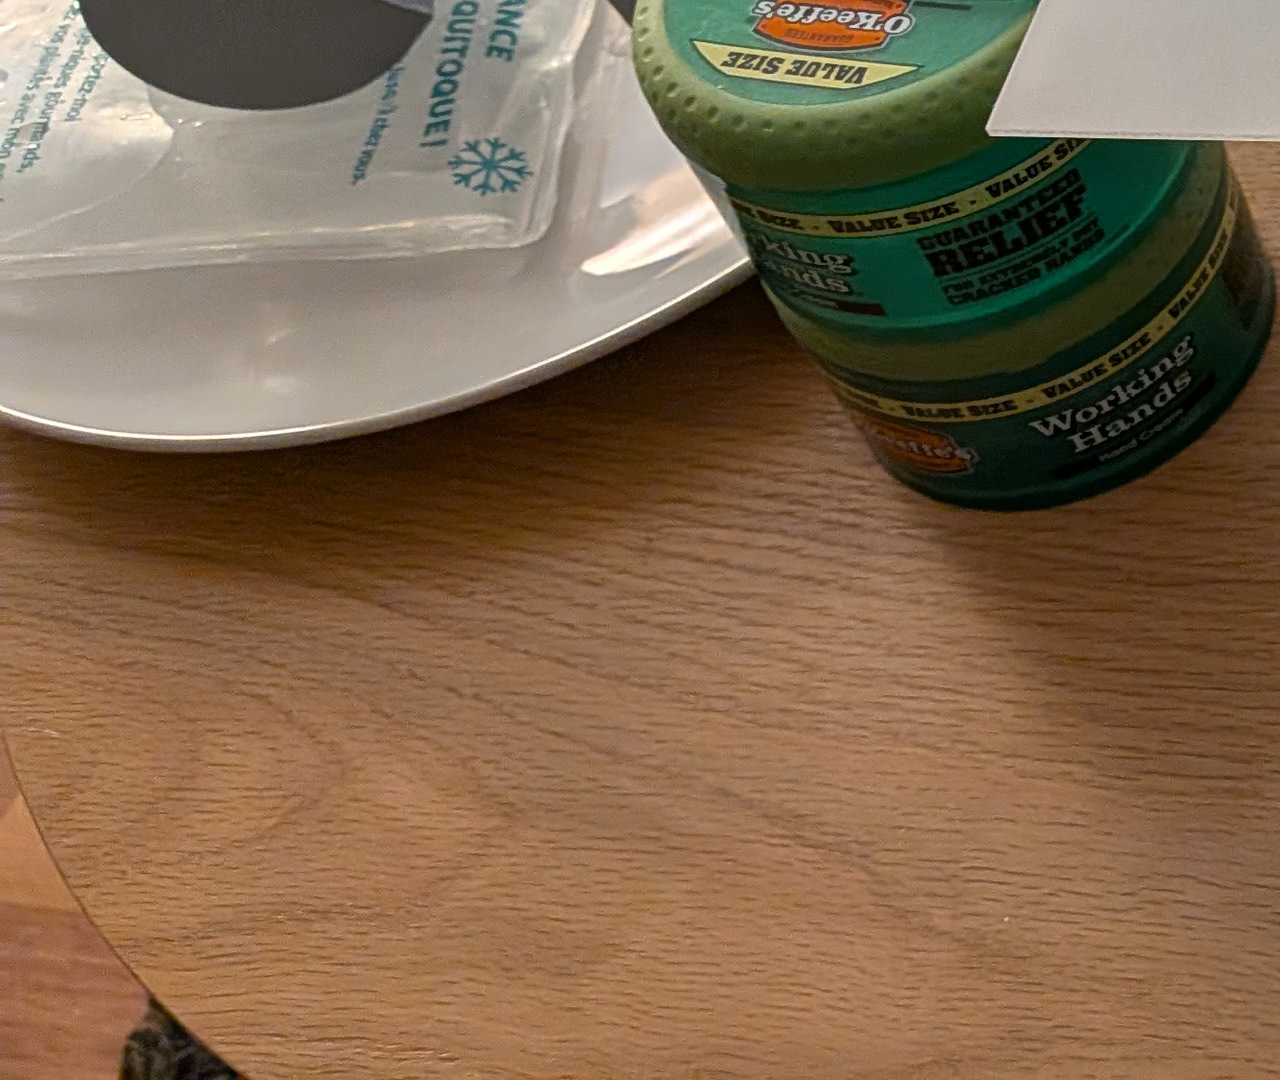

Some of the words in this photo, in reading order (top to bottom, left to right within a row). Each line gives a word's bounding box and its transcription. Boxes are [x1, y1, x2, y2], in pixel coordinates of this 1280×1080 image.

[423, 0, 480, 137] QUITOQUE
[720, 51, 785, 77] SIZE
[787, 58, 869, 85] VALUE
[827, 216, 902, 234] VALUE
[903, 201, 960, 226] SIZE
[985, 154, 1053, 199] VALUE
[917, 168, 1083, 251] GUARANTEED
[924, 183, 1087, 278] RELIEF
[1028, 335, 1195, 437] Working
[1042, 363, 1110, 399] VALUE
[1108, 331, 1152, 367] SIZE
[1067, 370, 1193, 453] Hands
